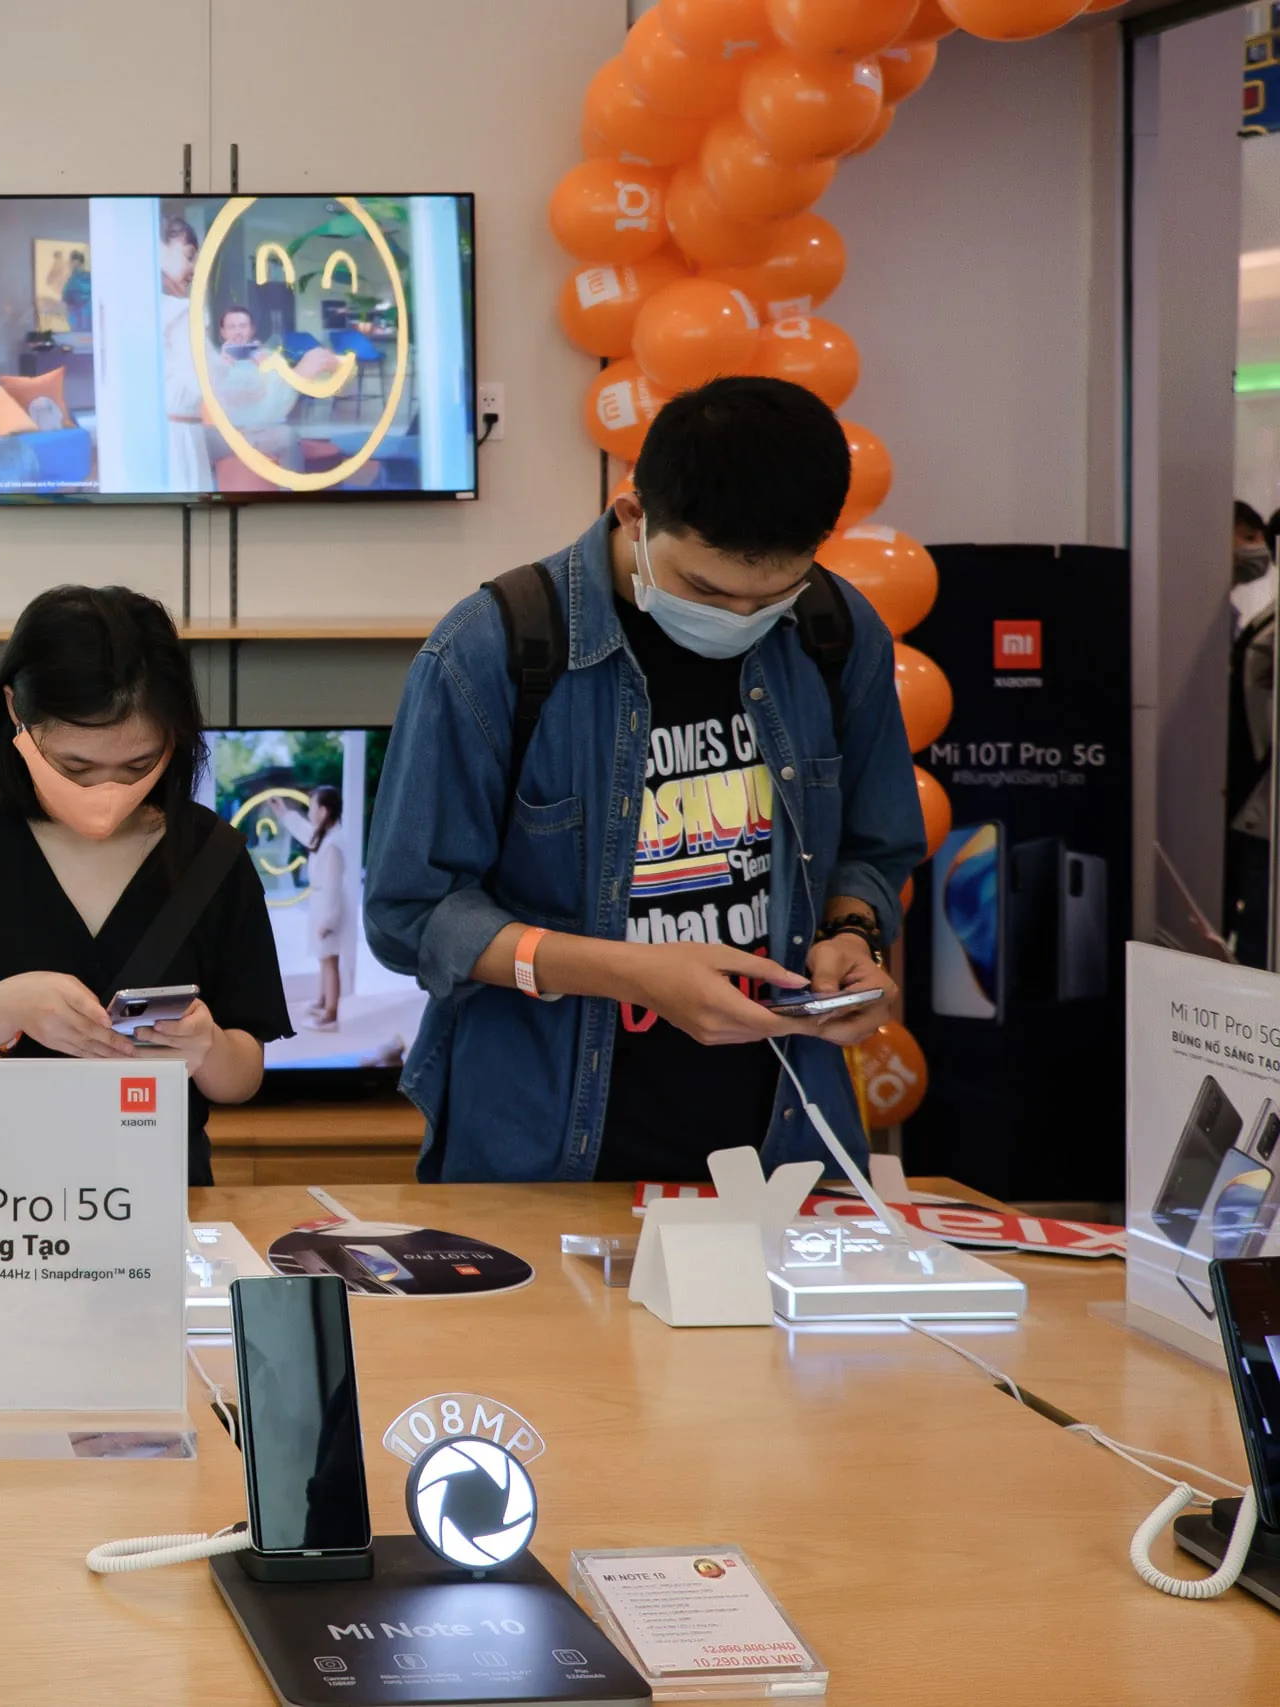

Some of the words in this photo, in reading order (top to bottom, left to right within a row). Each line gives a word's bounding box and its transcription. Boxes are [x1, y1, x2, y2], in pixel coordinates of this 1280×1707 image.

[930, 743, 961, 766] Mi
[966, 742, 1012, 766] 10T
[1020, 743, 1062, 767] Pro
[1073, 744, 1106, 767] 5G
[1171, 1000, 1189, 1022] Mi
[1192, 1007, 1220, 1030] 10T
[1225, 1015, 1253, 1040] Pro
[1260, 1024, 1280, 1048] 5G
[1172, 1030, 1201, 1049] BÙNG
[1224, 1045, 1255, 1064] SÁNG
[127, 1087, 150, 1102] mi
[120, 1119, 157, 1127] xiaomi
[78, 1187, 131, 1221] 5G
[22, 1234, 70, 1260] Tạo
[128, 1268, 152, 1280] 865
[390, 1400, 535, 1459] 108MP
[603, 1574, 617, 1582] MI
[619, 1573, 650, 1581] NOTE
[653, 1572, 666, 1580] 10
[327, 1623, 375, 1640] Mi
[380, 1622, 474, 1639] Note
[480, 1619, 526, 1635] 10
[693, 1655, 770, 1668] 10.290.000
[770, 1653, 805, 1664] VND
